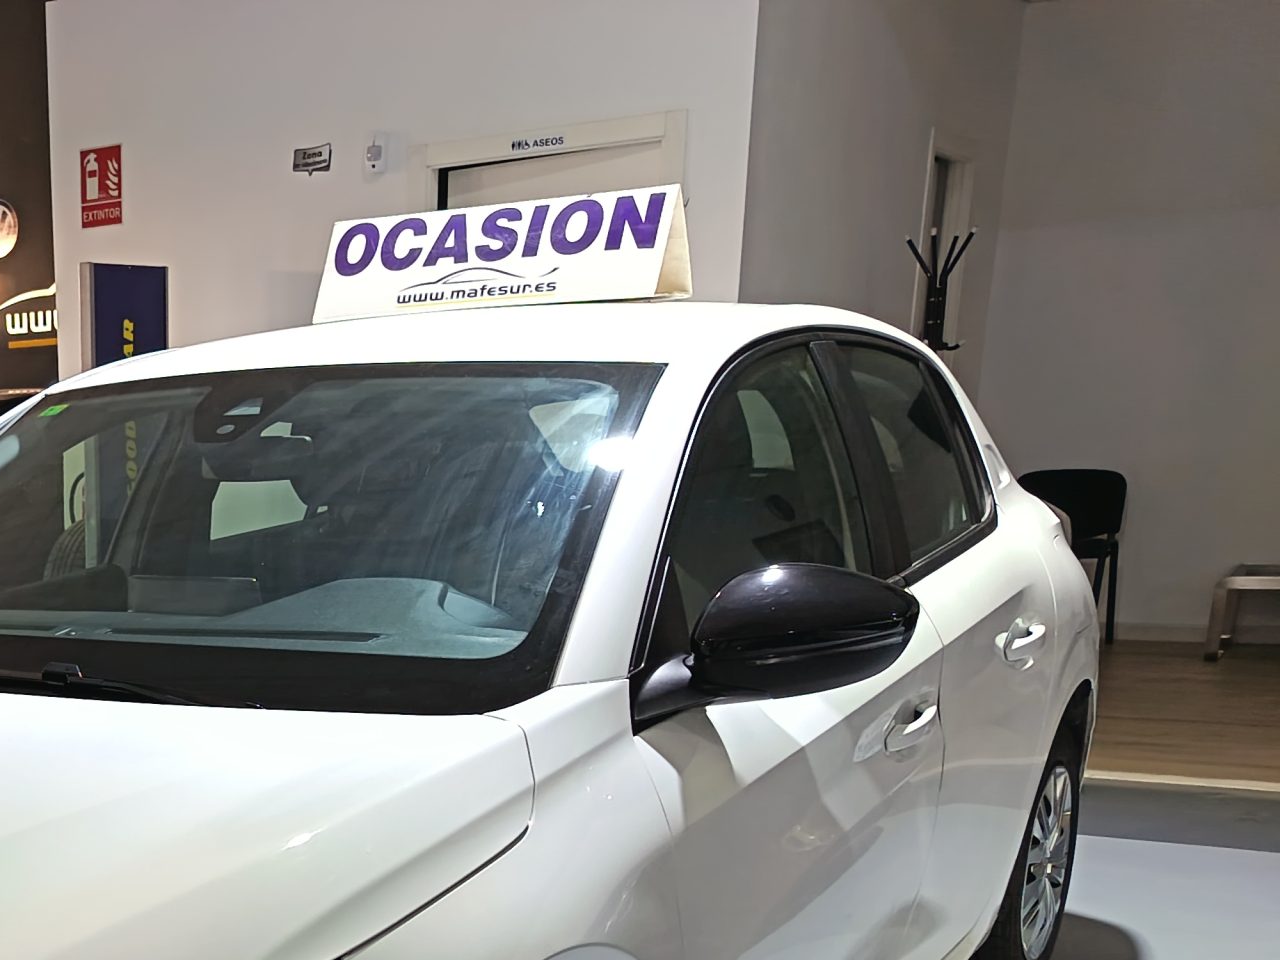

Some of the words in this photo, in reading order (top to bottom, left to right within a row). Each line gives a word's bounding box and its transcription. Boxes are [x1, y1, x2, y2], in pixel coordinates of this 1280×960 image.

[532, 136, 564, 148] ASEOS
[83, 207, 121, 223] EXTINTOR
[333, 192, 667, 277] OCASION
[396, 280, 558, 304] www.mafesur.es
[5, 310, 58, 335] ww
